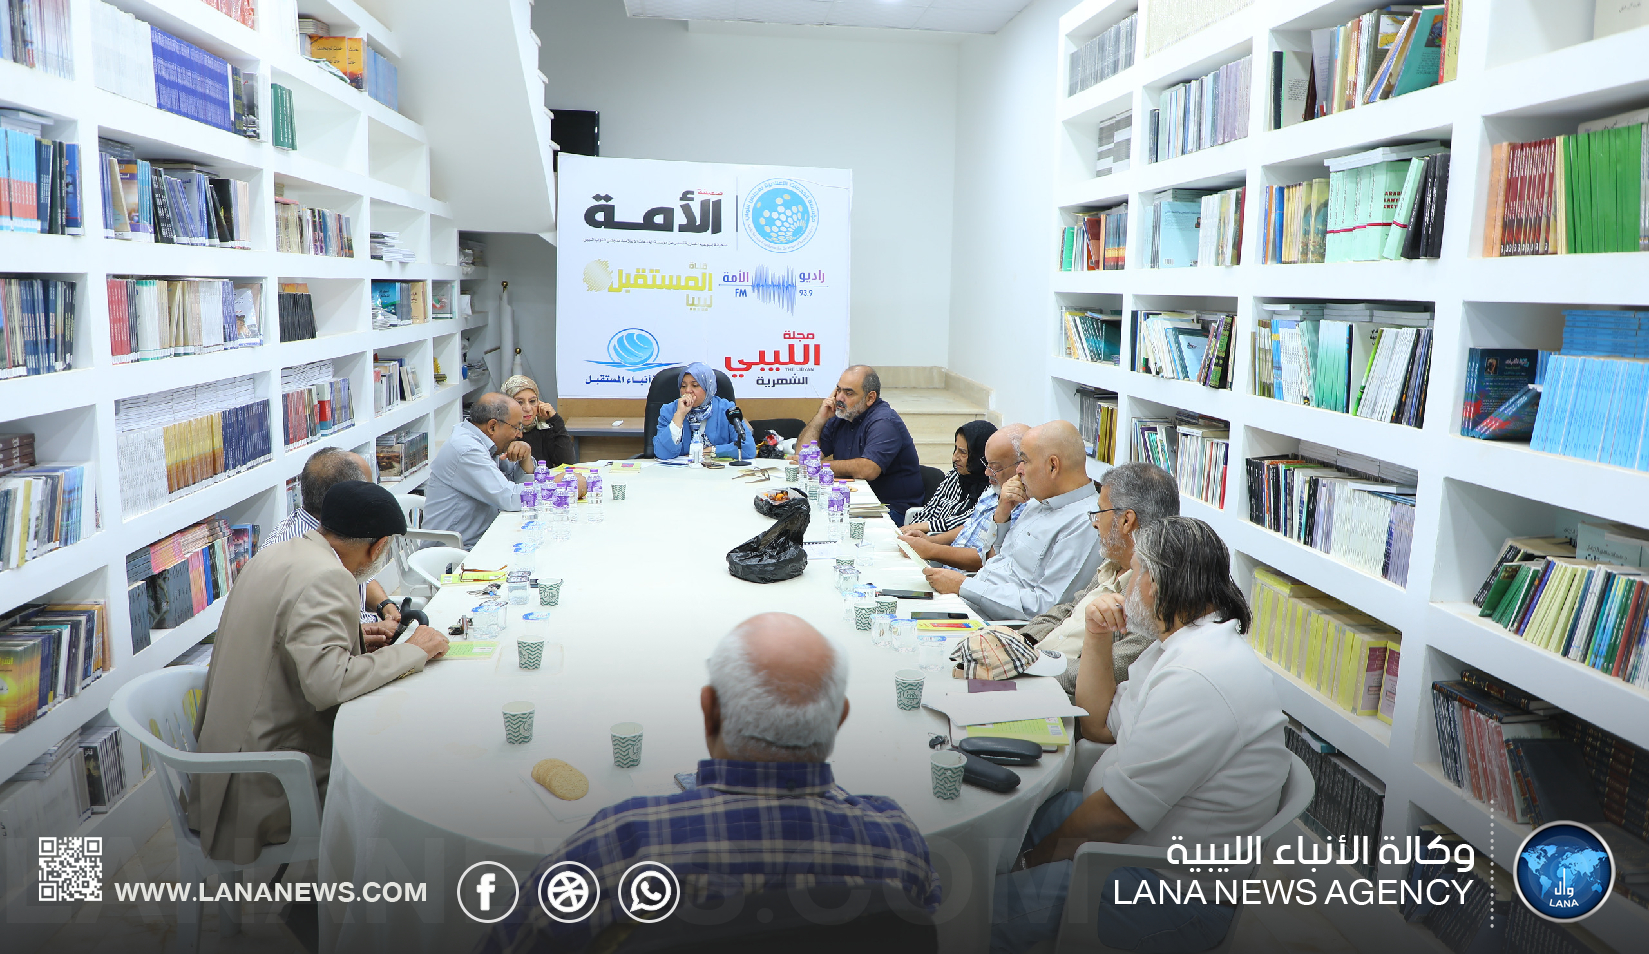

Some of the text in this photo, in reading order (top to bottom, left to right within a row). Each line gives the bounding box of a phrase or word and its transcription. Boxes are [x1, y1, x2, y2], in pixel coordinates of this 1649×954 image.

[583, 190, 722, 235] الأمة
[688, 261, 708, 269] قناة
[608, 267, 713, 293] المستقبل
[722, 269, 825, 284] راديو الأمة
[735, 288, 748, 298] FM
[799, 289, 813, 297] 93.9
[686, 293, 713, 311] ليبيا
[783, 330, 815, 342] مجلة
[724, 343, 821, 378] الليبي
[585, 374, 625, 386] المستقبل
[756, 373, 808, 388] الشهرية
